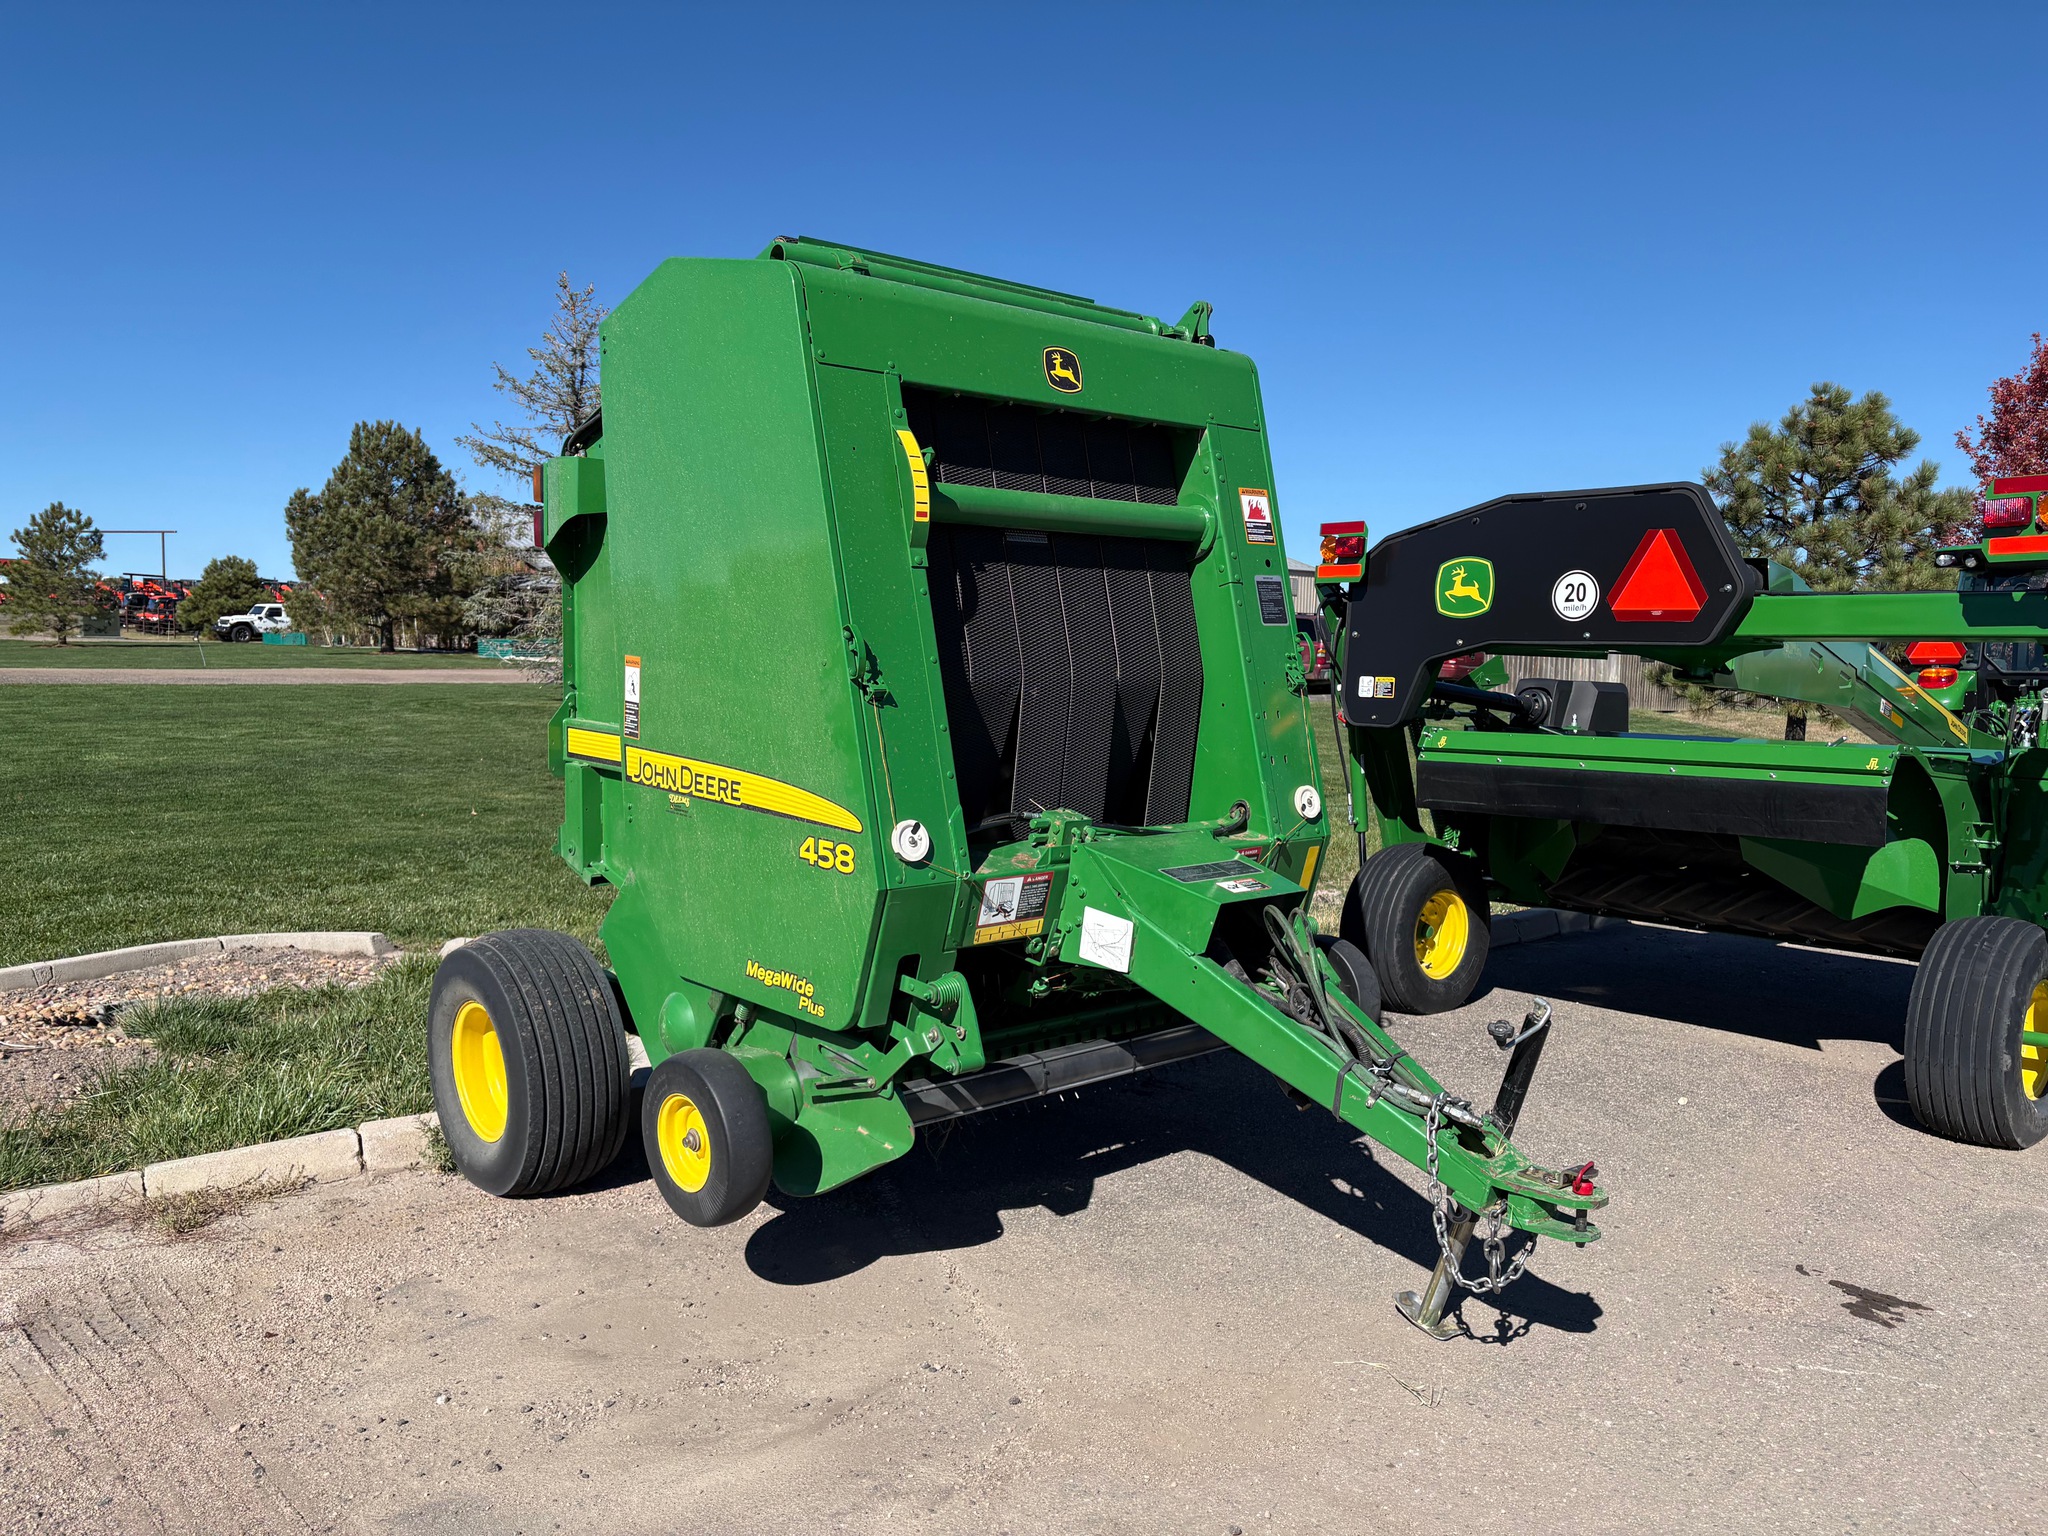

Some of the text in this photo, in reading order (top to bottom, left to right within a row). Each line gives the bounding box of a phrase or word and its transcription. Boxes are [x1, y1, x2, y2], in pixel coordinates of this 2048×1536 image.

[1564, 583, 1586, 602] 20
[633, 756, 742, 802] JOHN DEERE
[799, 836, 856, 875] 458
[746, 959, 815, 998] MegaWide
[798, 995, 826, 1018] Plus
